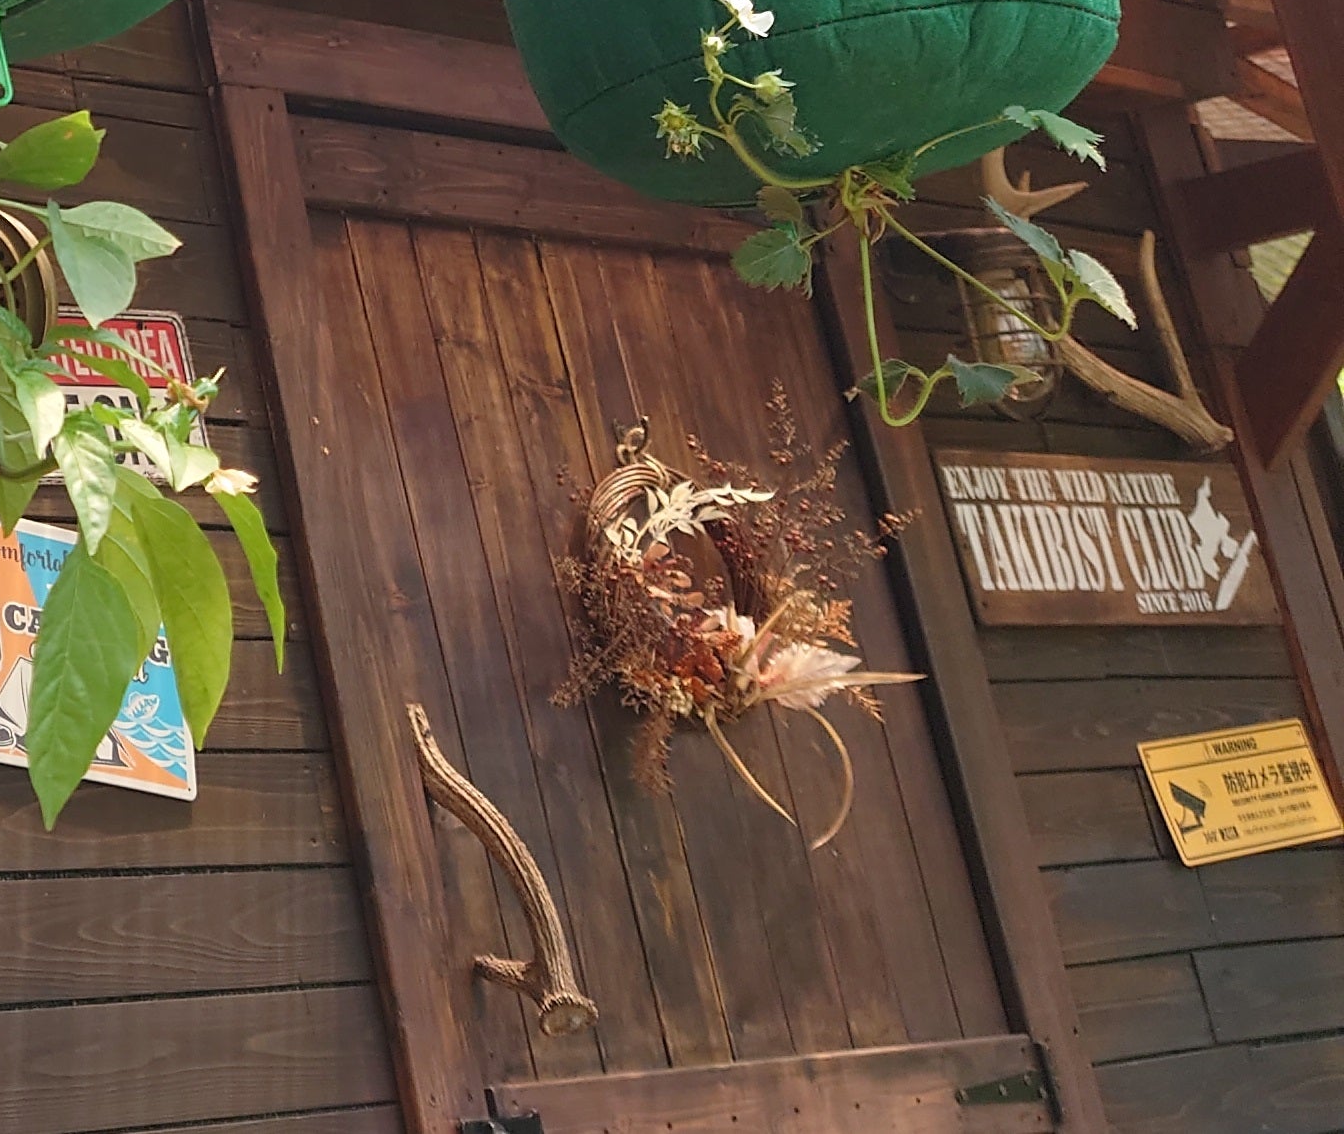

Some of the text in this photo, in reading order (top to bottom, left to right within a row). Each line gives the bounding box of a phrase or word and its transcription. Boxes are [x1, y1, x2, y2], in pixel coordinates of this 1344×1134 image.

[941, 465, 1181, 505] ENJOY THE WILD NATURE
[953, 503, 1206, 592] TAKIBIST CLUB
[1135, 590, 1213, 614] SINCE 2016
[1212, 737, 1258, 755] WARNING
[1222, 759, 1312, 794] 防犯カメラ監視中
